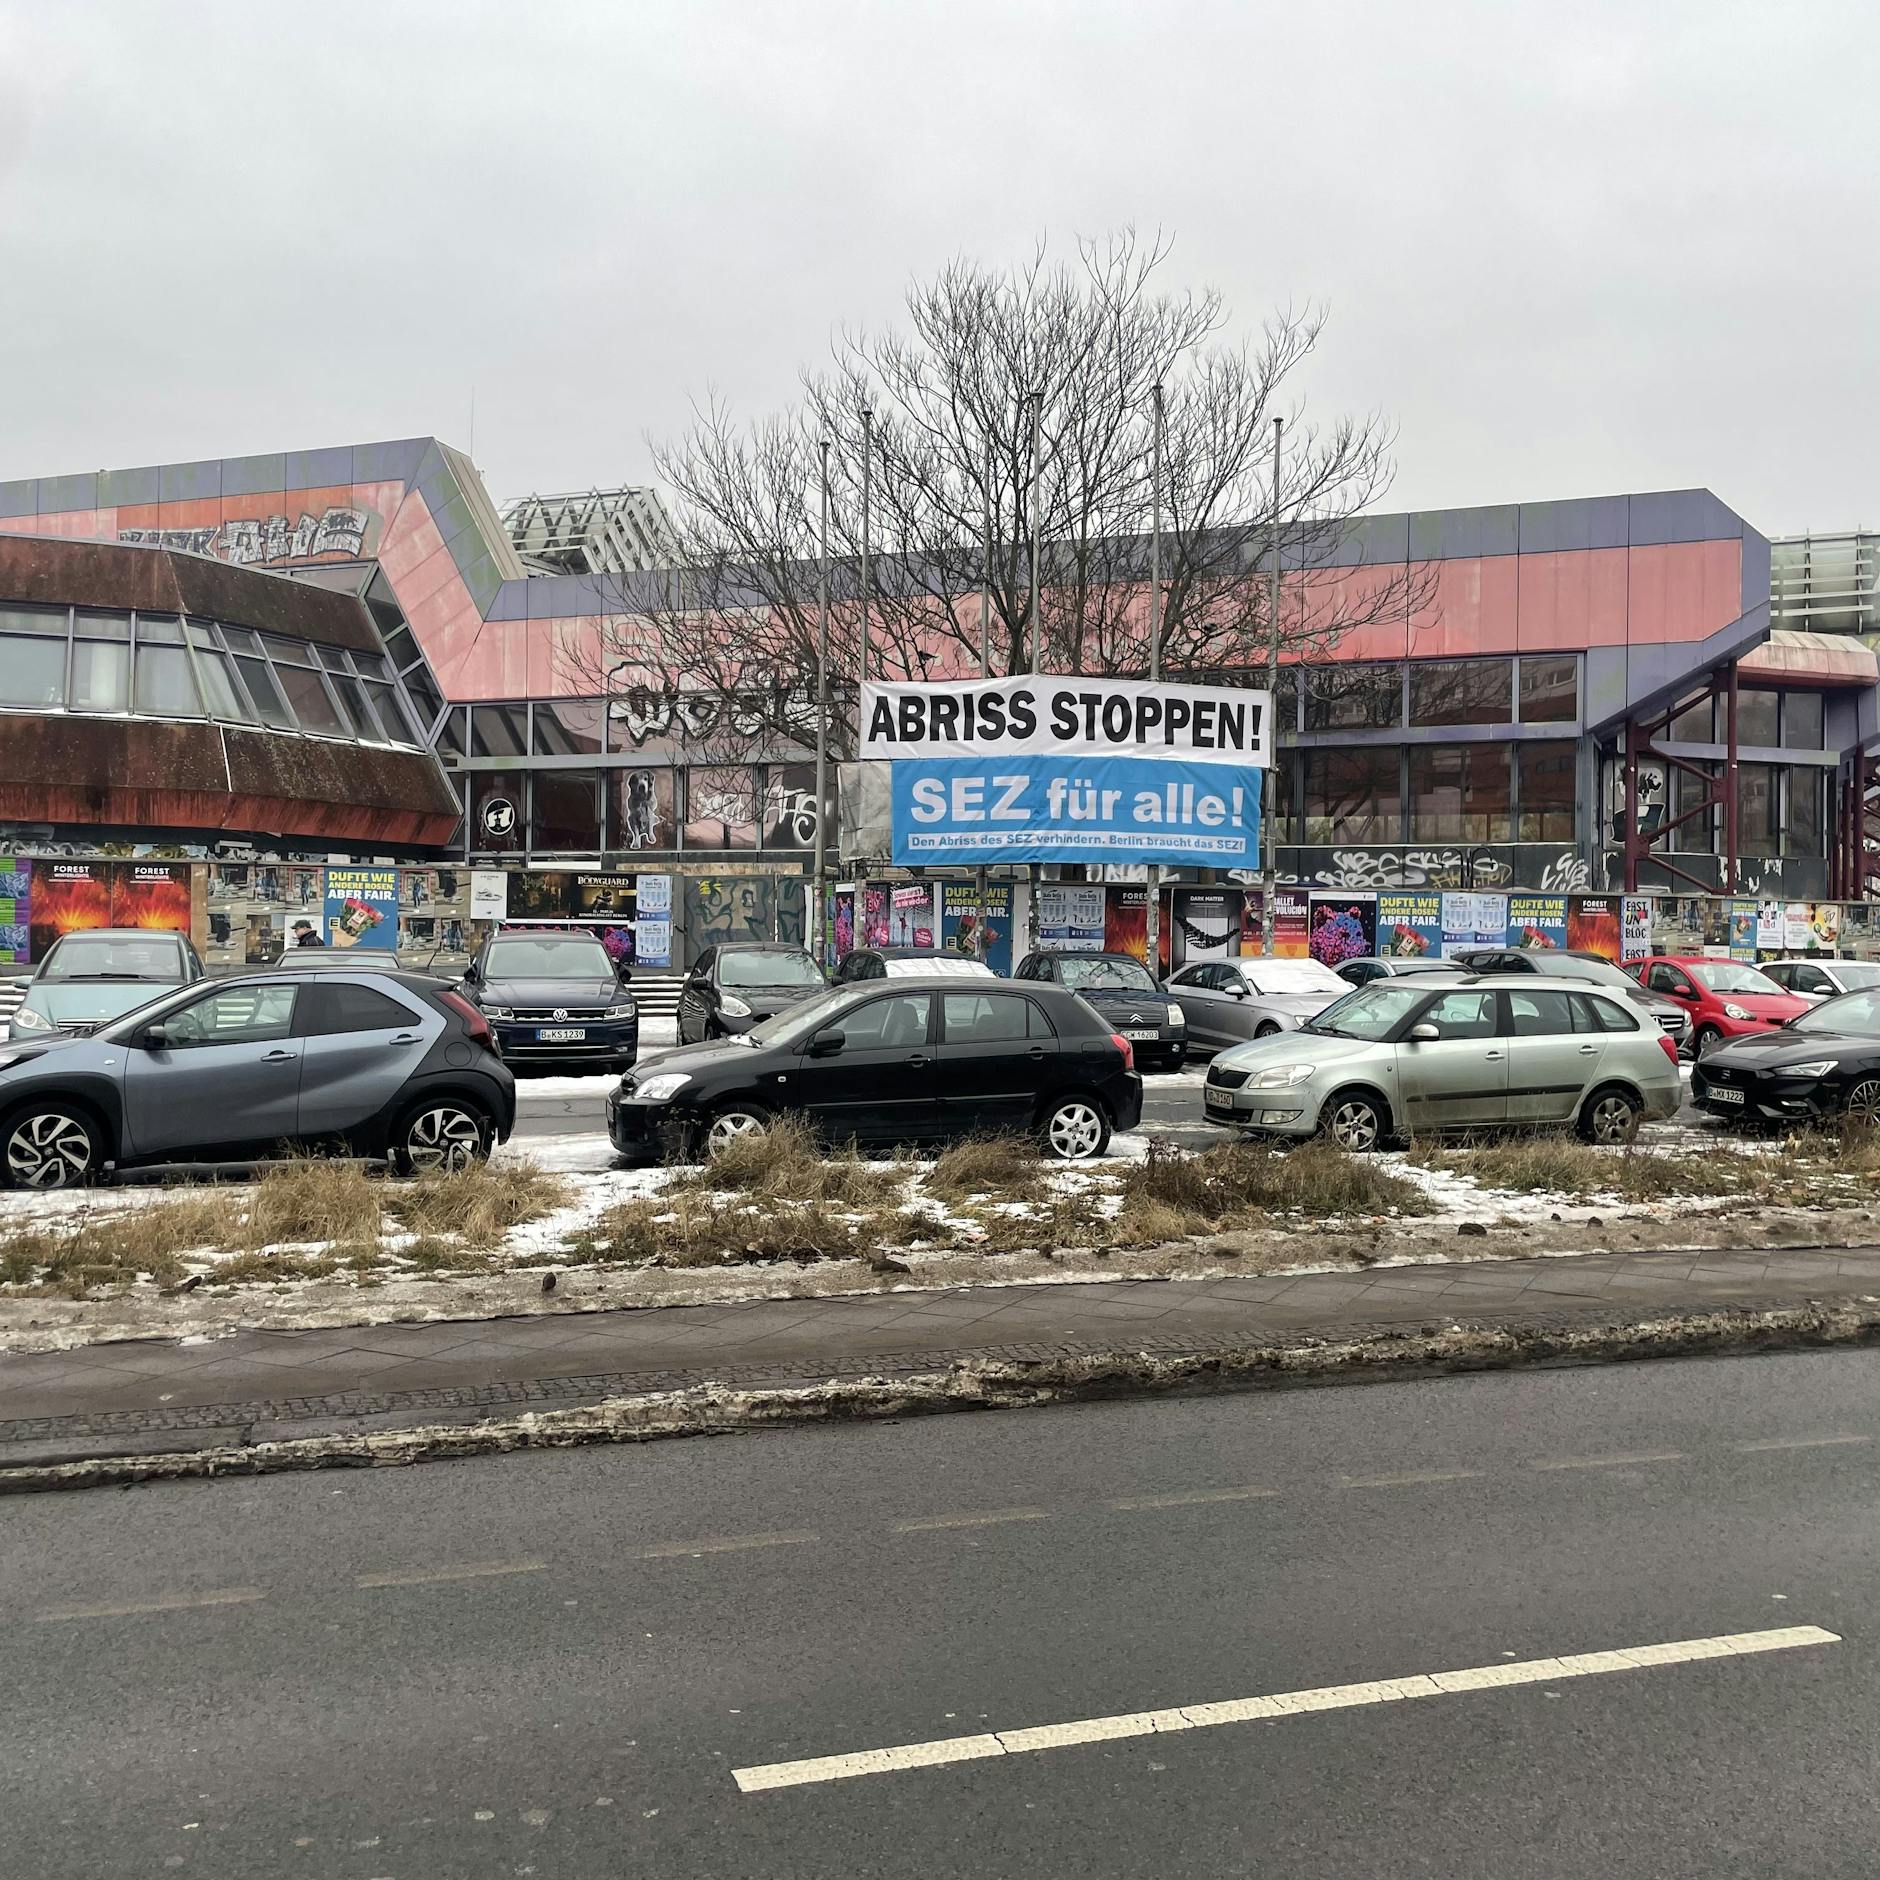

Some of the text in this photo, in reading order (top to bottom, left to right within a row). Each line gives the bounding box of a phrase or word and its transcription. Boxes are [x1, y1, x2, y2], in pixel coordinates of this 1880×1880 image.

[868, 690, 1037, 742] ABRISS
[1050, 691, 1263, 751] STOPPEN!
[911, 775, 1244, 827] SEZ für alle!
[912, 833, 1243, 850] Den Abriss des SEZ verhindern. Berlin braucht das SEZ!
[53, 865, 90, 873] FOREST
[134, 867, 170, 875] FOREST
[328, 871, 396, 883] DUFTE WIE
[577, 875, 629, 886] BODYGUARD
[328, 889, 396, 901] ABER FAIR.
[944, 887, 976, 898] DUFT
[1122, 892, 1148, 900] FORES
[1379, 897, 1415, 908] DUFTE
[1417, 898, 1440, 908] WIE
[1510, 899, 1543, 909] DUFTE
[1545, 900, 1565, 910] WIE
[1582, 900, 1608, 908] FOREST
[1626, 901, 1647, 912] EAST
[944, 906, 1009, 918] ABER AIR.
[1379, 907, 1411, 915] ANDERE
[1510, 909, 1540, 917] ANDERE
[1379, 915, 1440, 926] ABER FAIR.
[1509, 917, 1565, 928] ABER FAIR.
[1625, 927, 1647, 939] BLOC
[541, 1031, 584, 1039] B KS 1239
[1137, 1031, 1158, 1039] 16203
[1726, 1091, 1744, 1102] 1222
